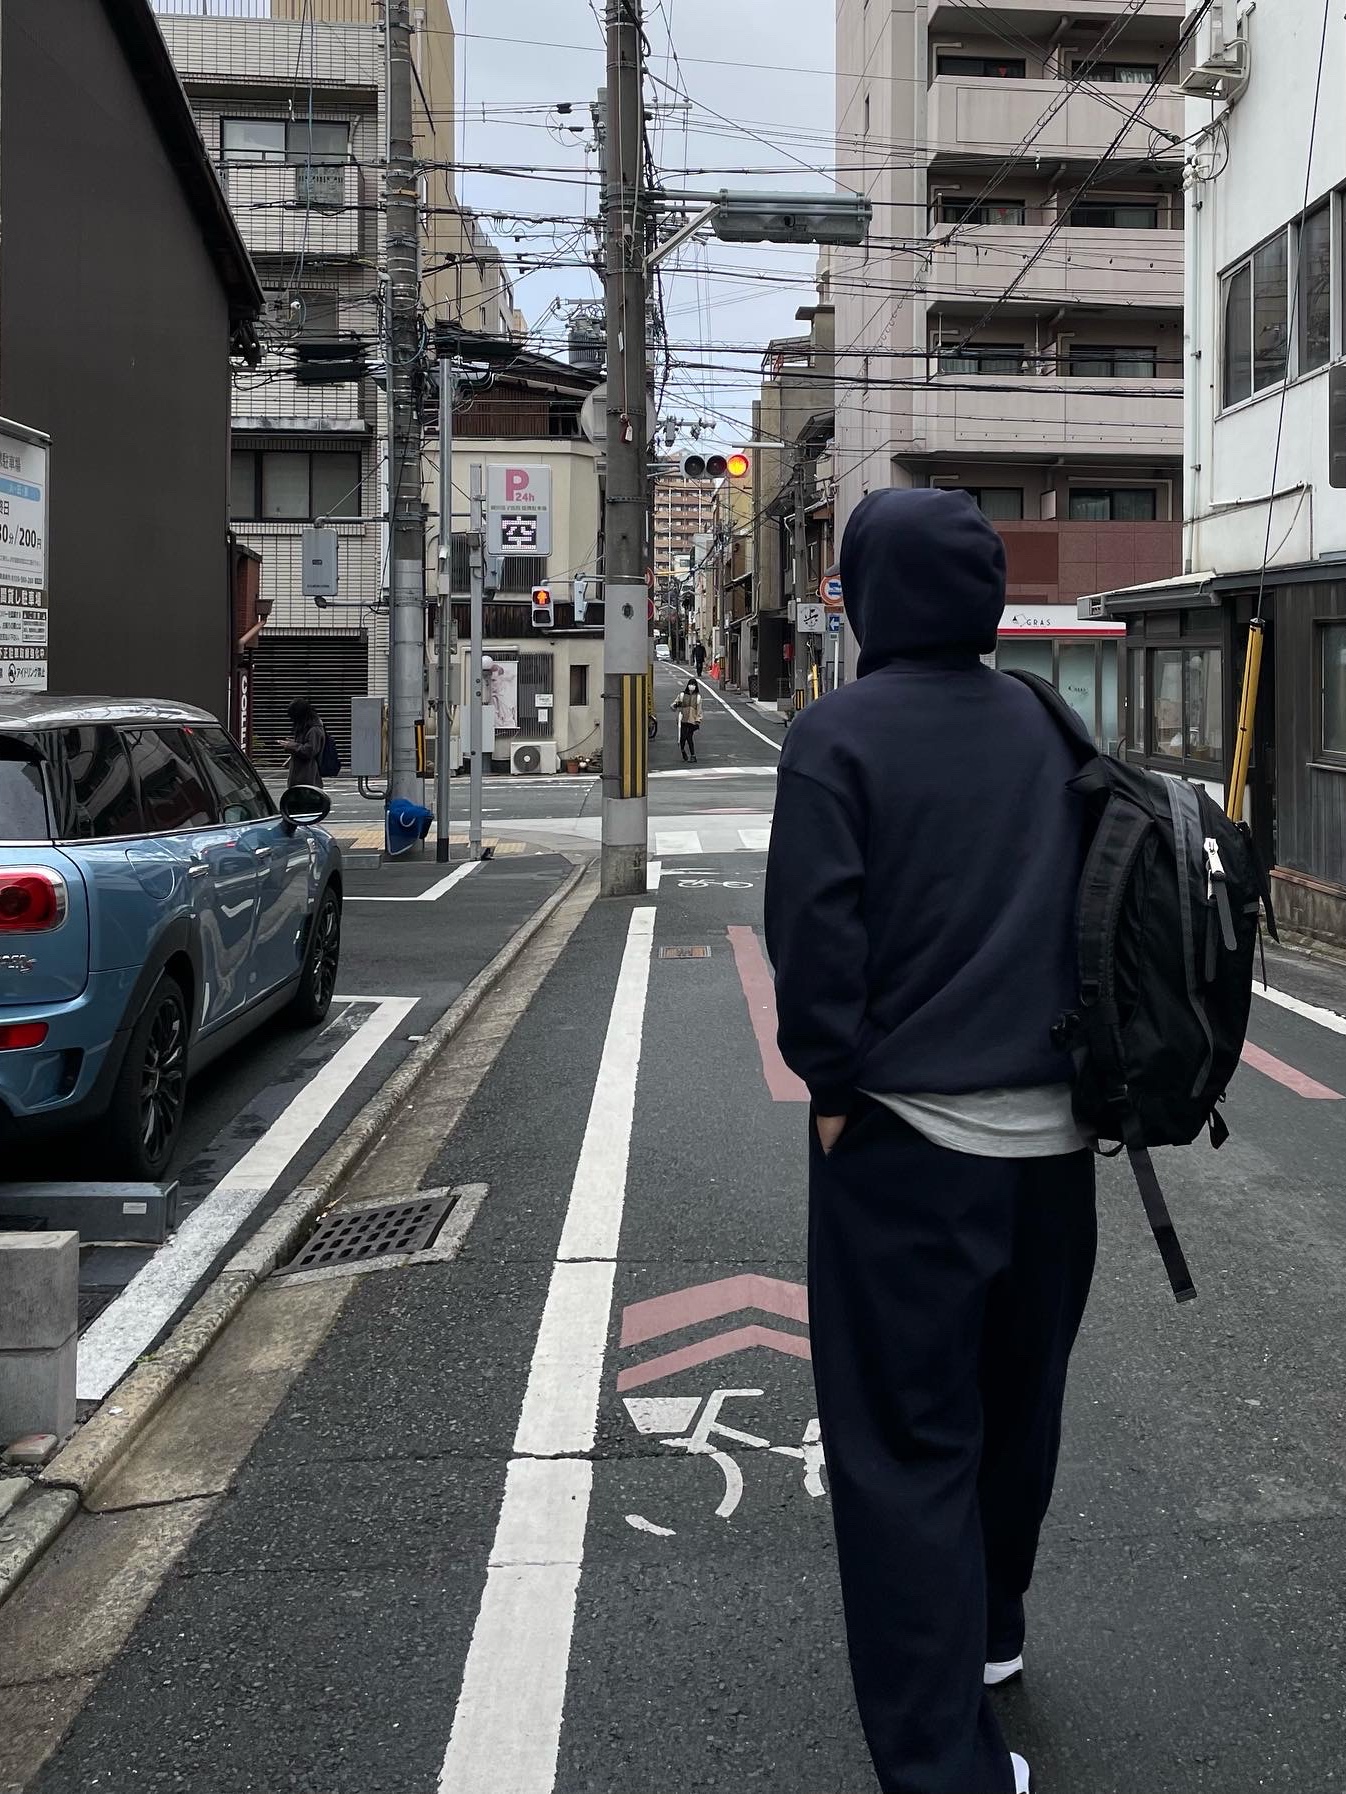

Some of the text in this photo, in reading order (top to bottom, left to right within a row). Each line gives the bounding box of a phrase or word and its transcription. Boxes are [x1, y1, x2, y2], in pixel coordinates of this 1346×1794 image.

[506, 469, 530, 502] P
[515, 492, 535, 502] 24h
[501, 516, 537, 550] 空
